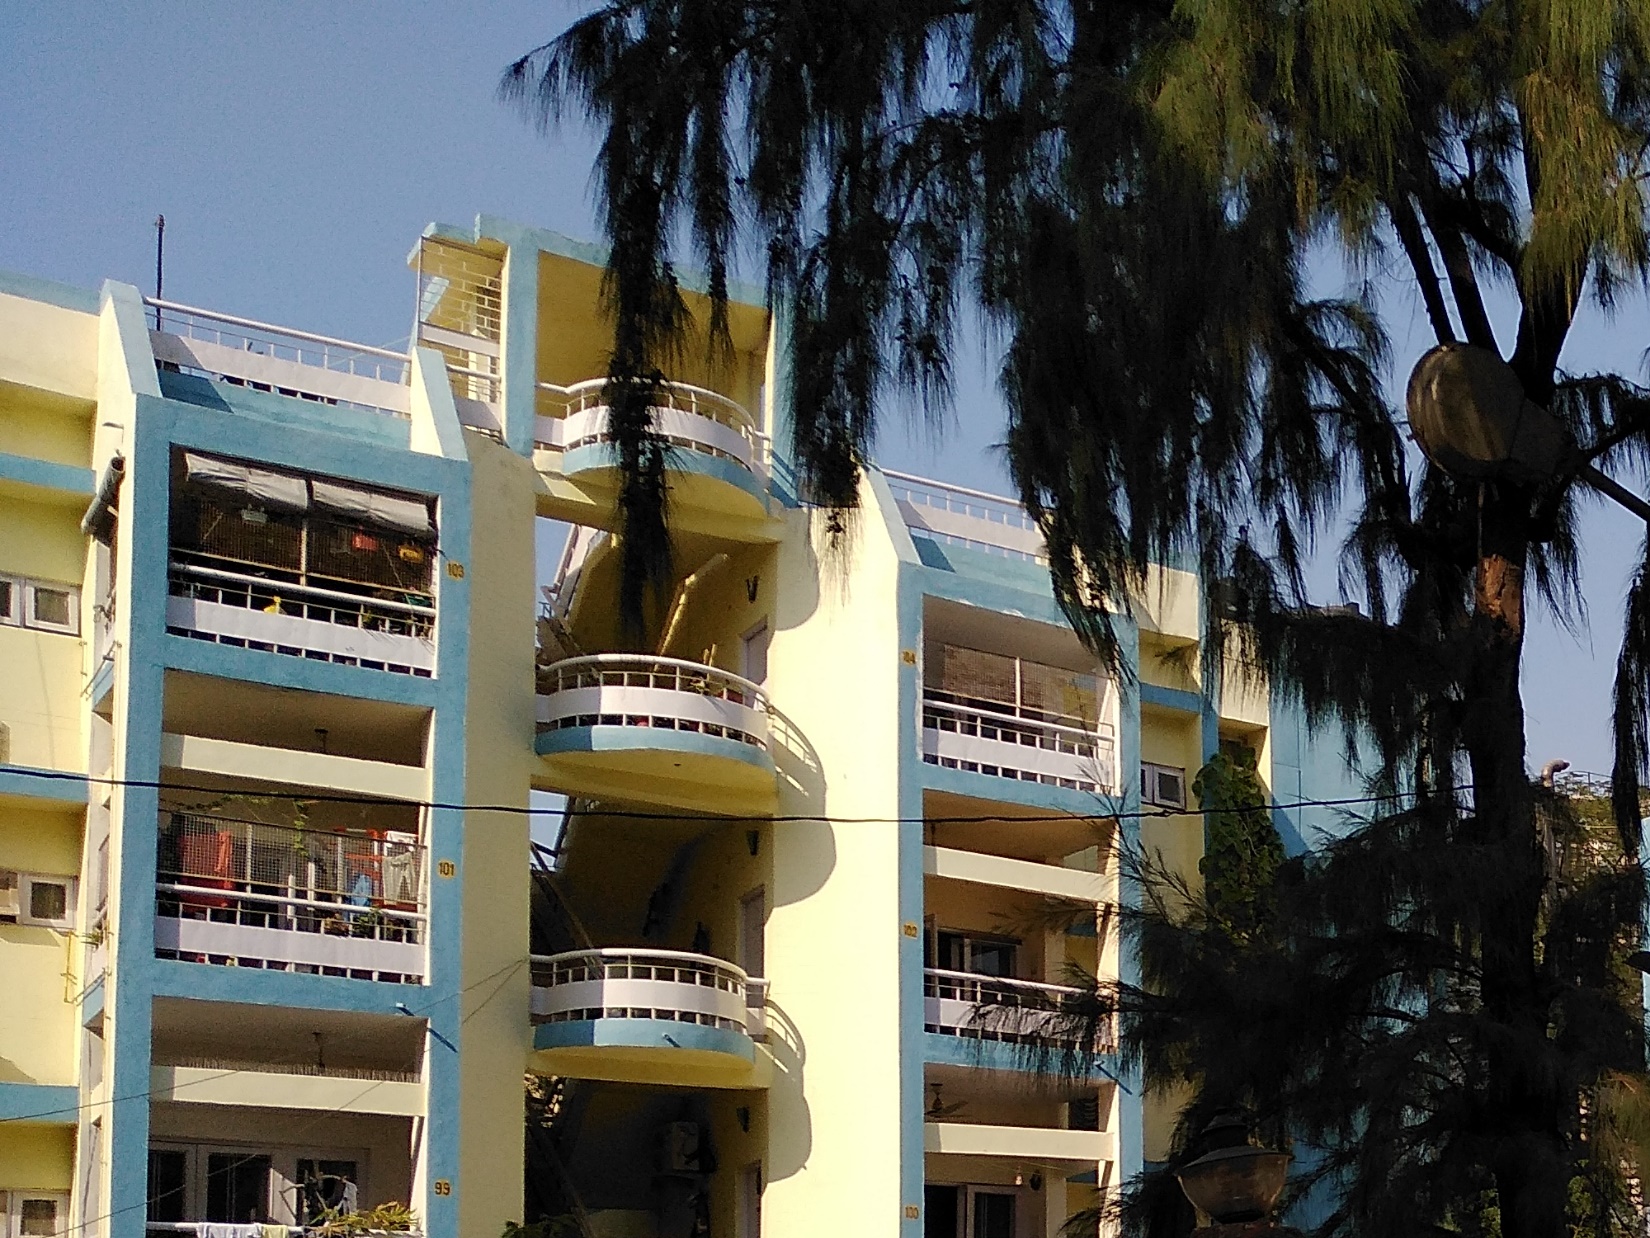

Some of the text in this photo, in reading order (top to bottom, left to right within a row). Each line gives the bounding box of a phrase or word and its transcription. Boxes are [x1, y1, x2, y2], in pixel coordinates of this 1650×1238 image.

[448, 563, 465, 578] 103
[438, 862, 455, 876] 101
[434, 1181, 451, 1196] 99
